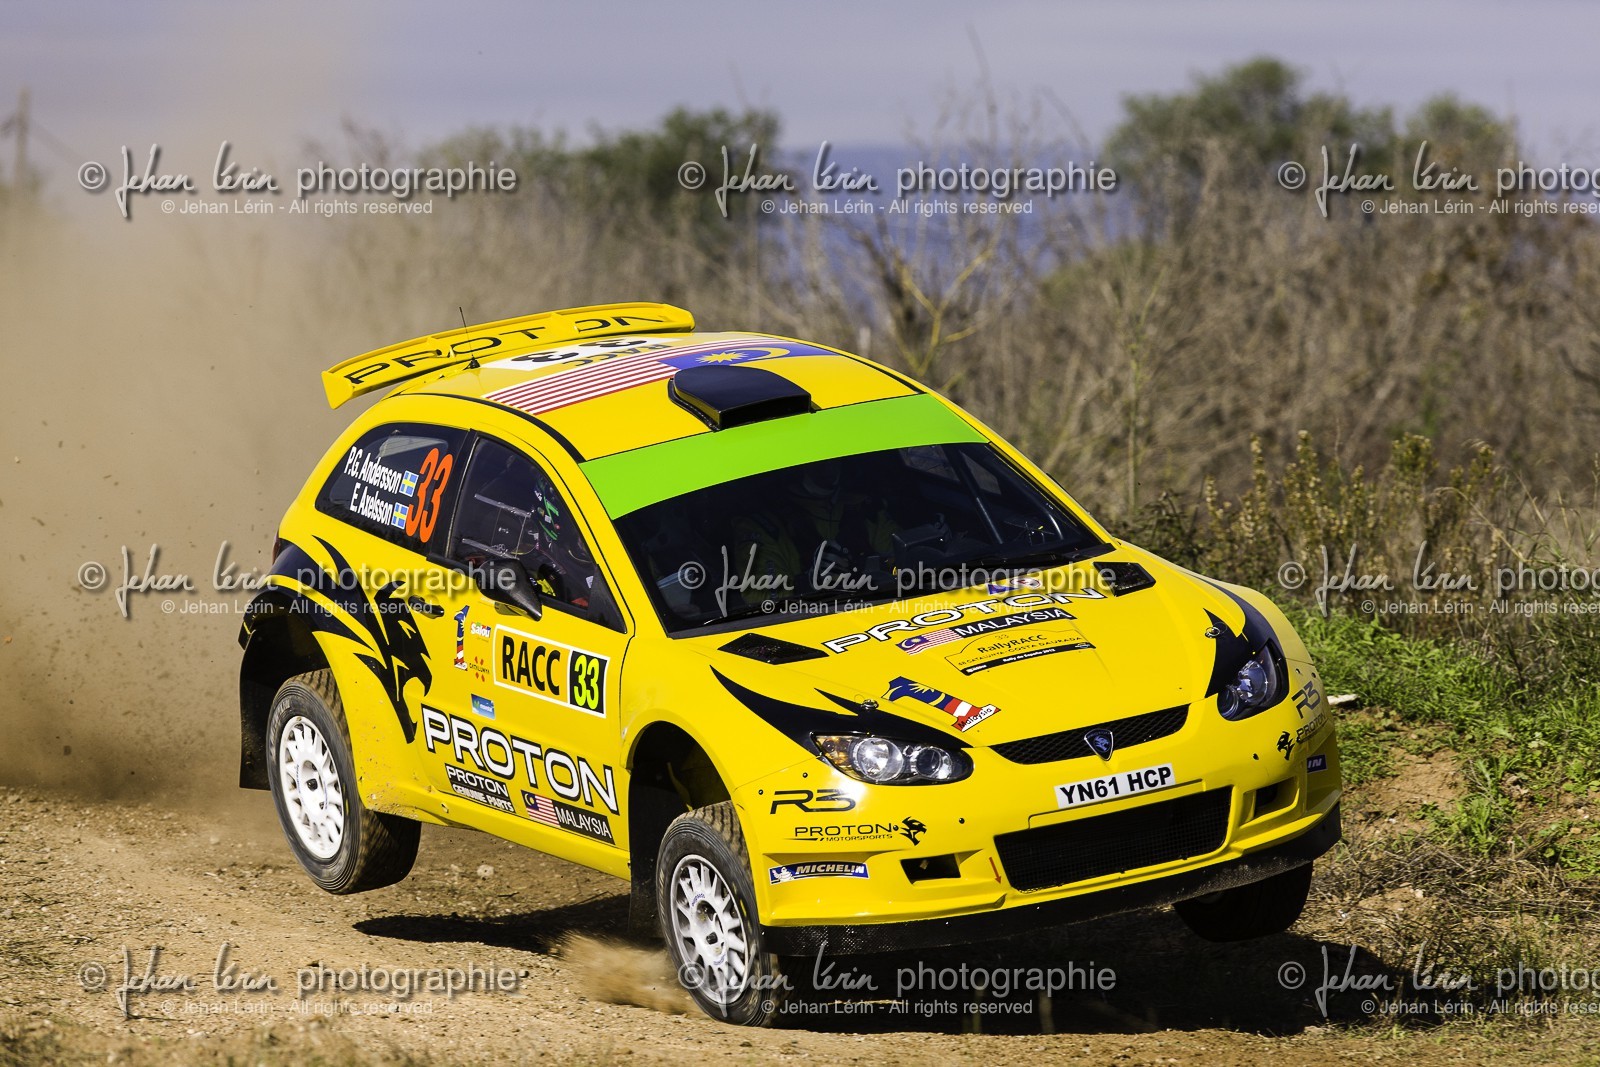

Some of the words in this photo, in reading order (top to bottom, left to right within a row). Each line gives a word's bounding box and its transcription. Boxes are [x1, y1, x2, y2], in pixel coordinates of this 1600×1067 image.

[344, 316, 666, 385] PROTON
[561, 343, 672, 367] RACC
[344, 445, 363, 478] P.G.
[359, 452, 402, 494] Andersson
[350, 482, 361, 512] E.
[357, 486, 393, 526] Axelsson
[406, 447, 454, 543] 33
[821, 586, 1108, 655] PROTON
[954, 607, 1073, 638] MALAYSIA
[977, 634, 1047, 654] RallyRACC
[502, 635, 560, 695] RACC
[573, 655, 600, 710] 33
[1291, 680, 1321, 719] R3
[958, 707, 993, 729] Malaysia
[1296, 712, 1326, 738] PROTON
[421, 703, 621, 816] PROTON
[446, 765, 508, 797] PROTON
[1060, 775, 1120, 805] YN61
[1127, 765, 1172, 793] HCP
[452, 783, 488, 804] GENUINE
[486, 794, 515, 813] PARTS
[770, 788, 857, 815] R3
[555, 806, 612, 839] MALAYSIA
[794, 822, 893, 837] PROTON
[826, 834, 893, 842] MOTORSPORTS
[795, 864, 865, 876] MICHELIN
